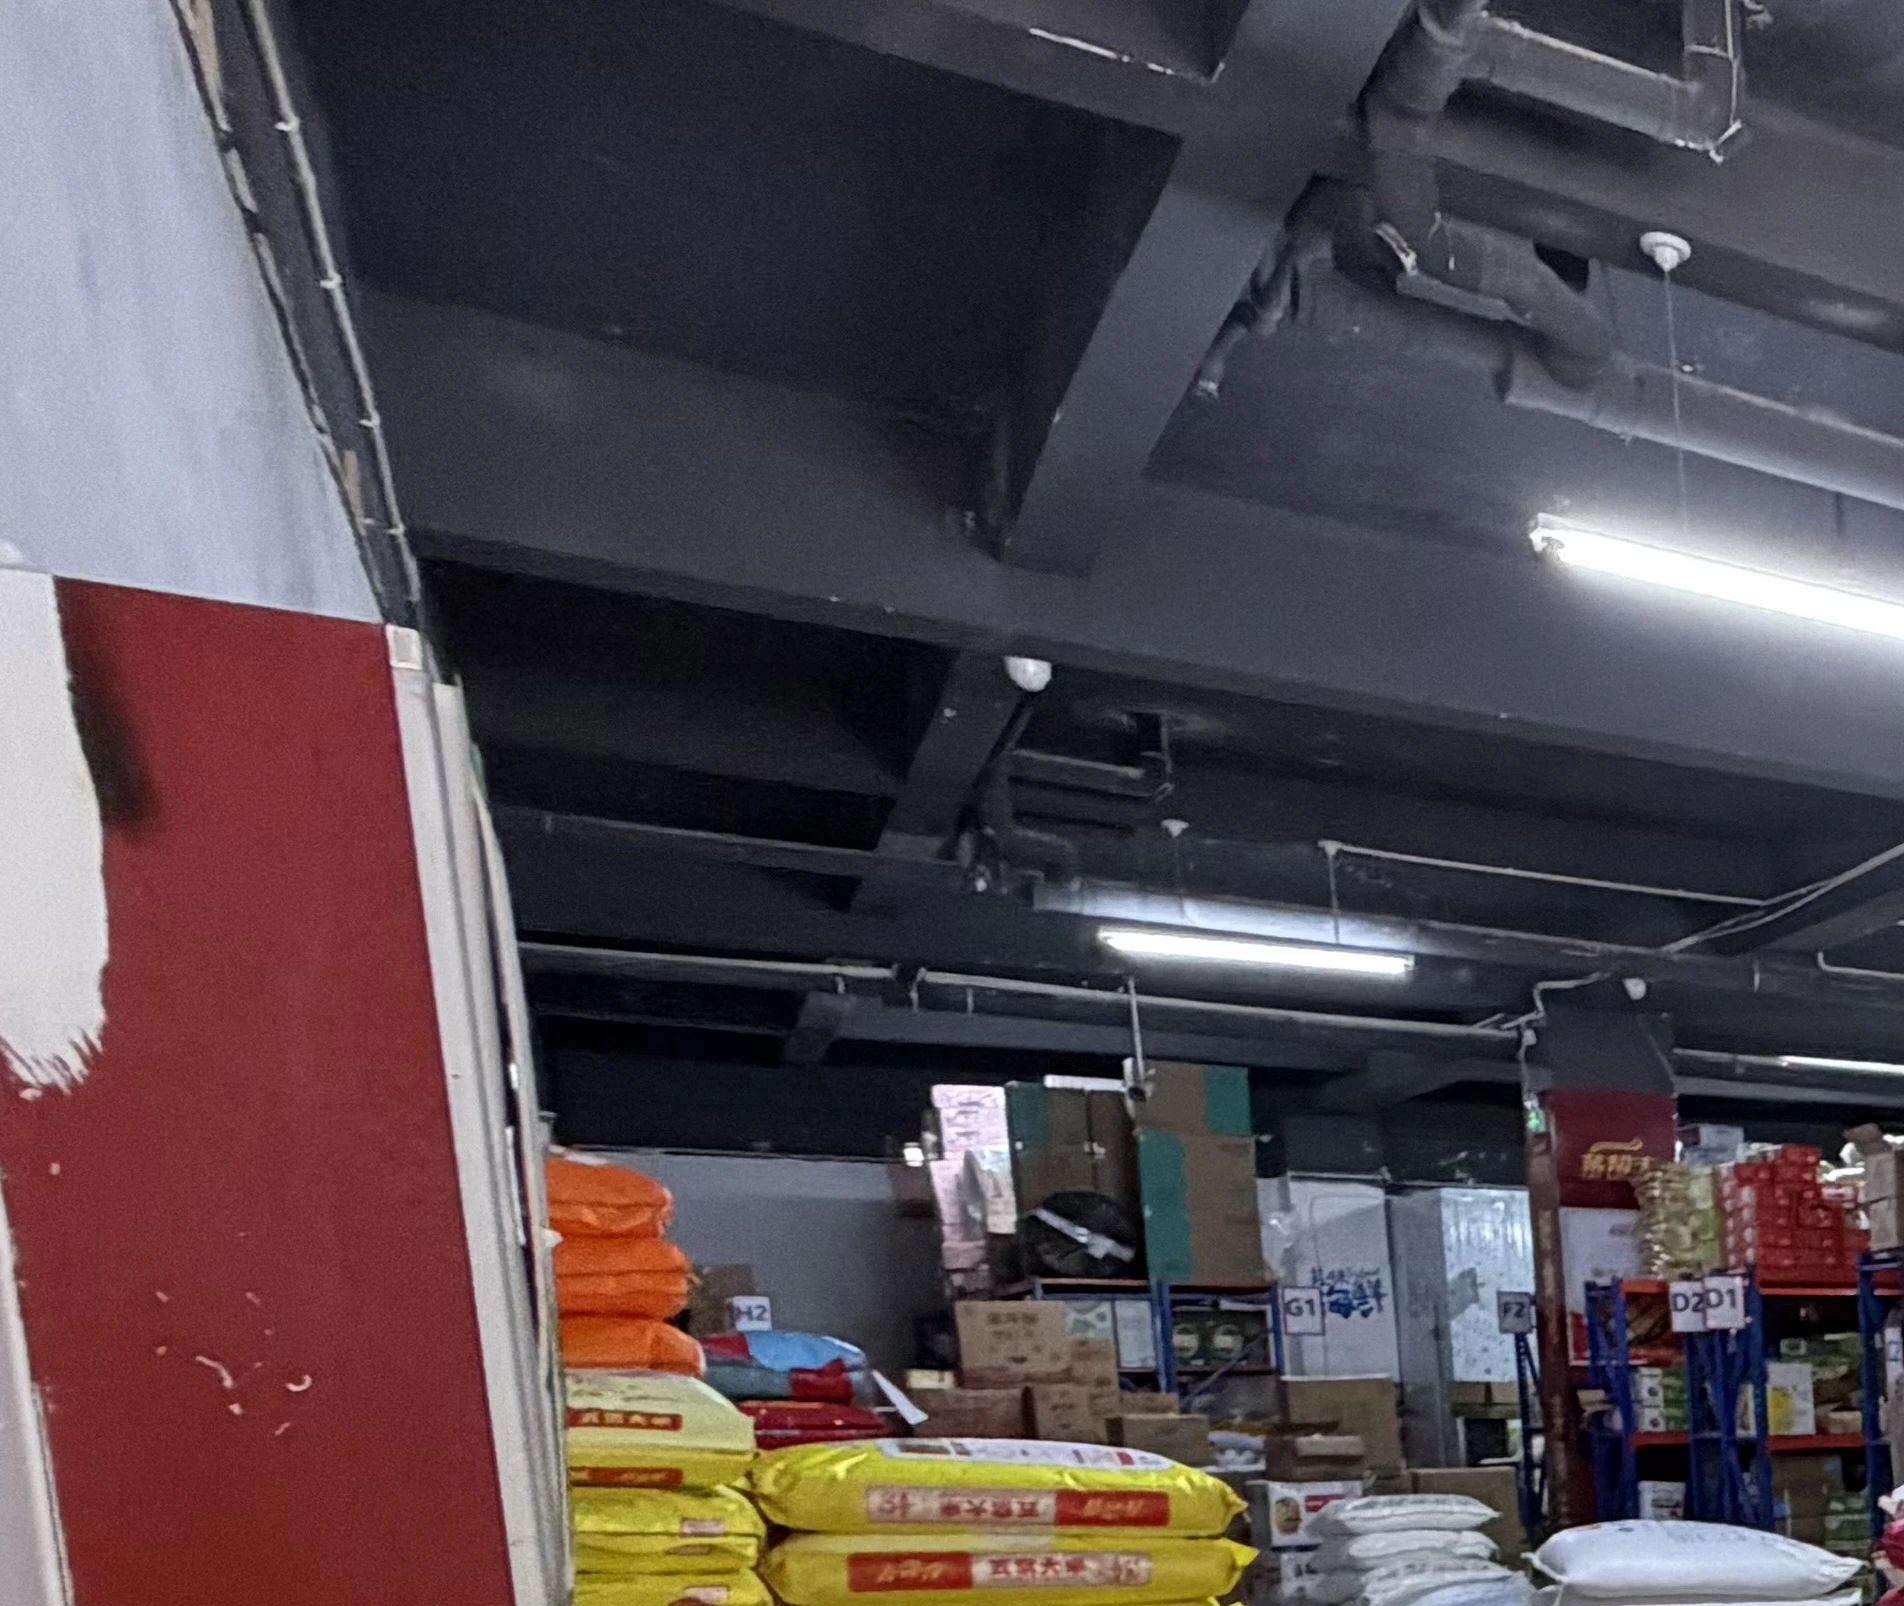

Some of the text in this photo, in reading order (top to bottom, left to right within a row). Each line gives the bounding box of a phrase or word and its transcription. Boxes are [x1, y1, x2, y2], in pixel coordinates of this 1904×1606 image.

[1286, 1296, 1317, 1318] G1
[1672, 1293, 1702, 1313] D2
[1704, 1286, 1737, 1310] D1
[735, 1302, 769, 1325] H2
[1503, 1302, 1525, 1319] F2
